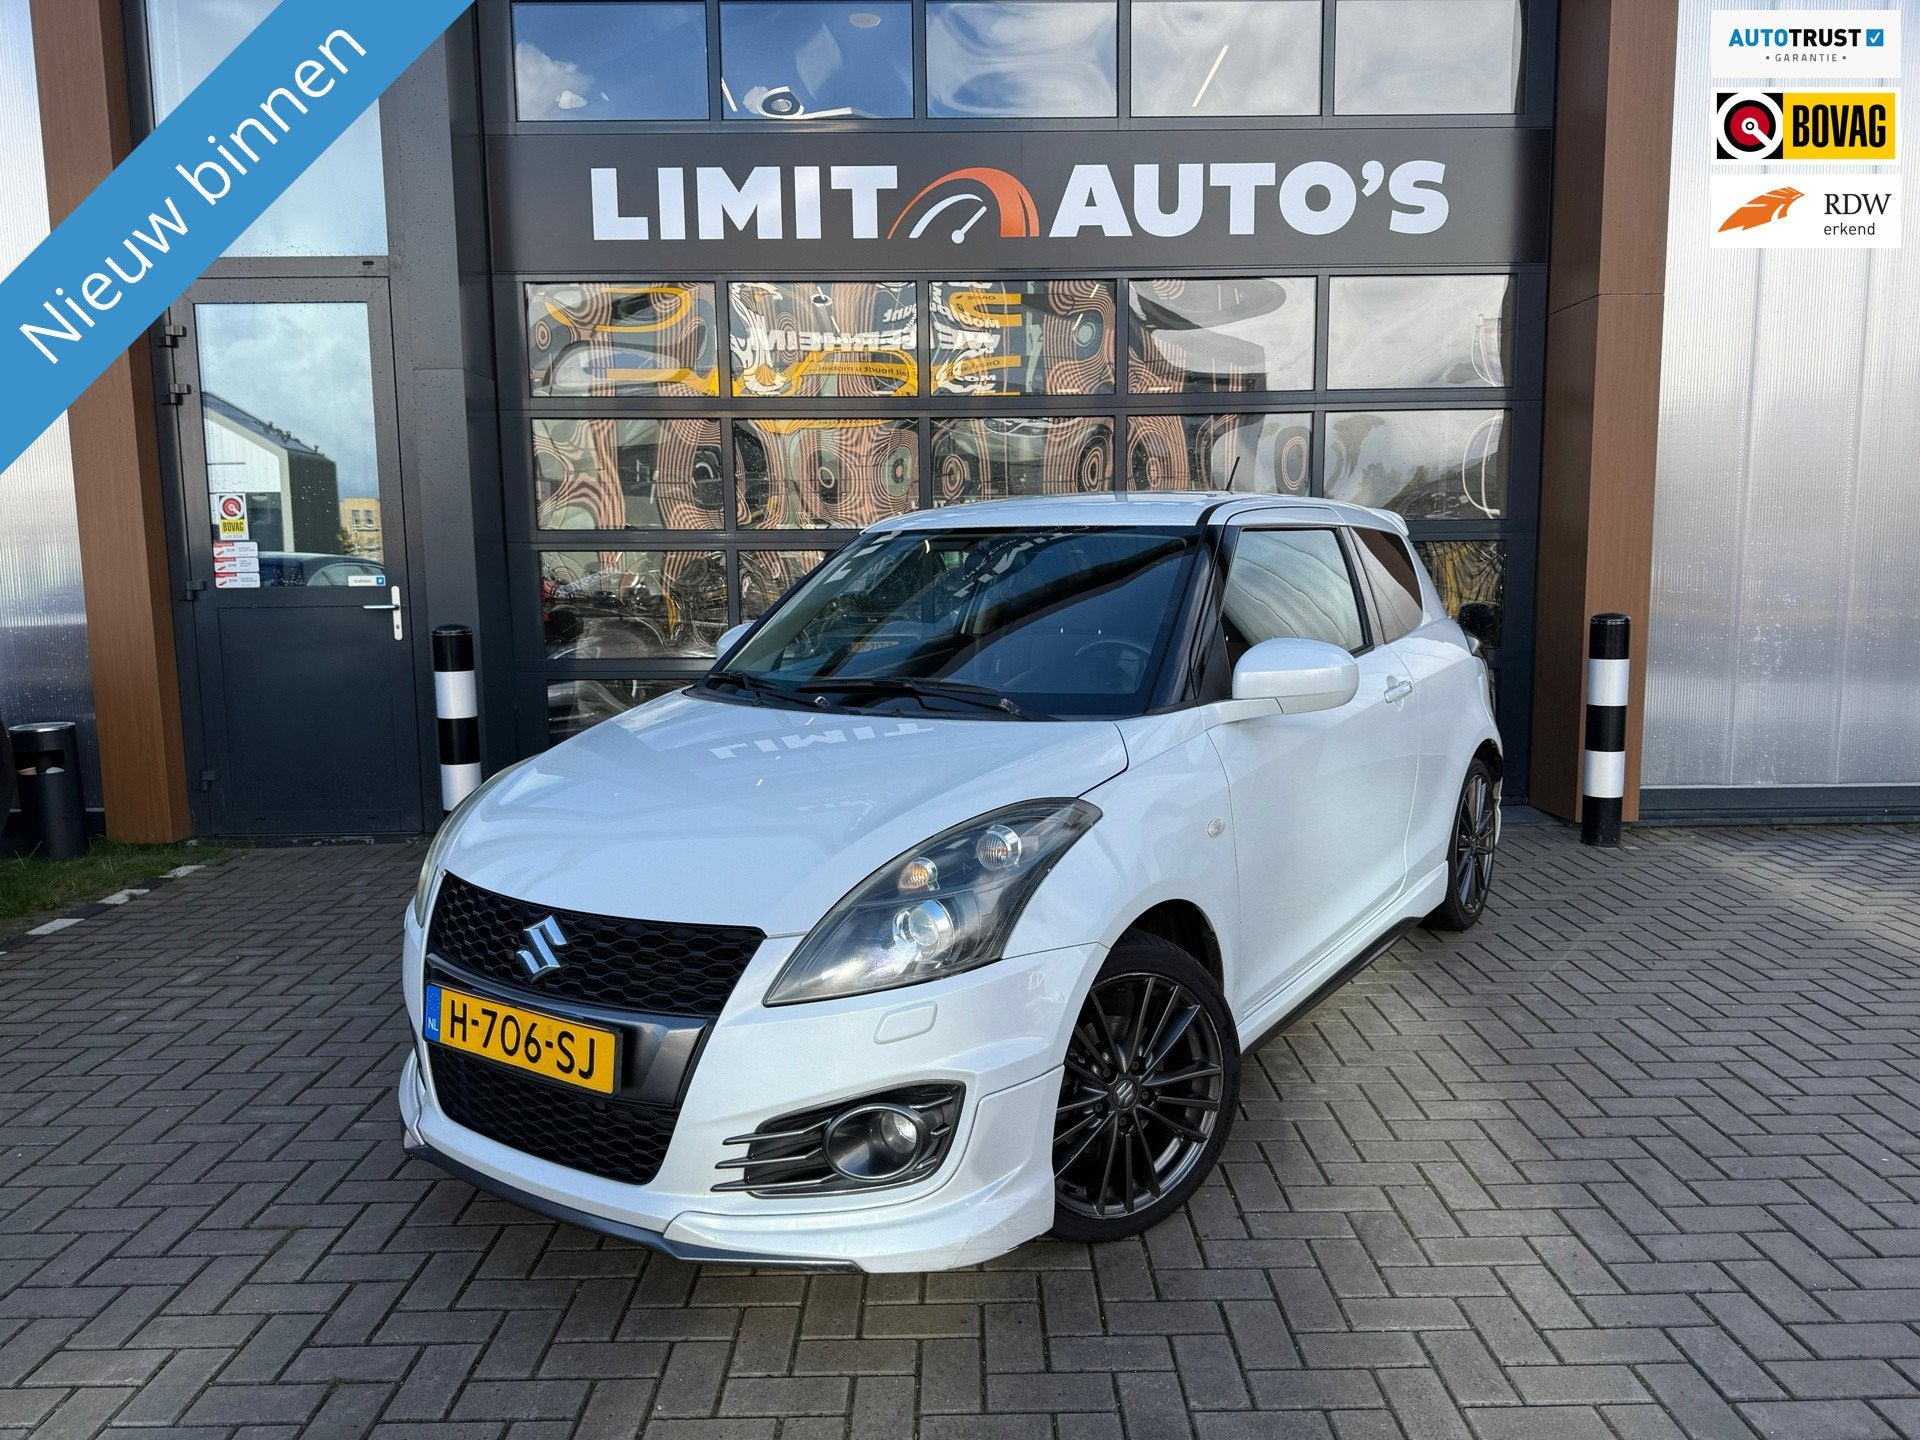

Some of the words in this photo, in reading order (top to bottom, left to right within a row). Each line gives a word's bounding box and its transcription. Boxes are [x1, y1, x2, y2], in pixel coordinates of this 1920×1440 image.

[590, 165, 898, 240] LIMIT
[1048, 159, 1450, 238] AUTO'S
[222, 521, 245, 532] BOVAG
[427, 1016, 440, 1032] NL
[450, 998, 596, 1080] H-706-SJ
